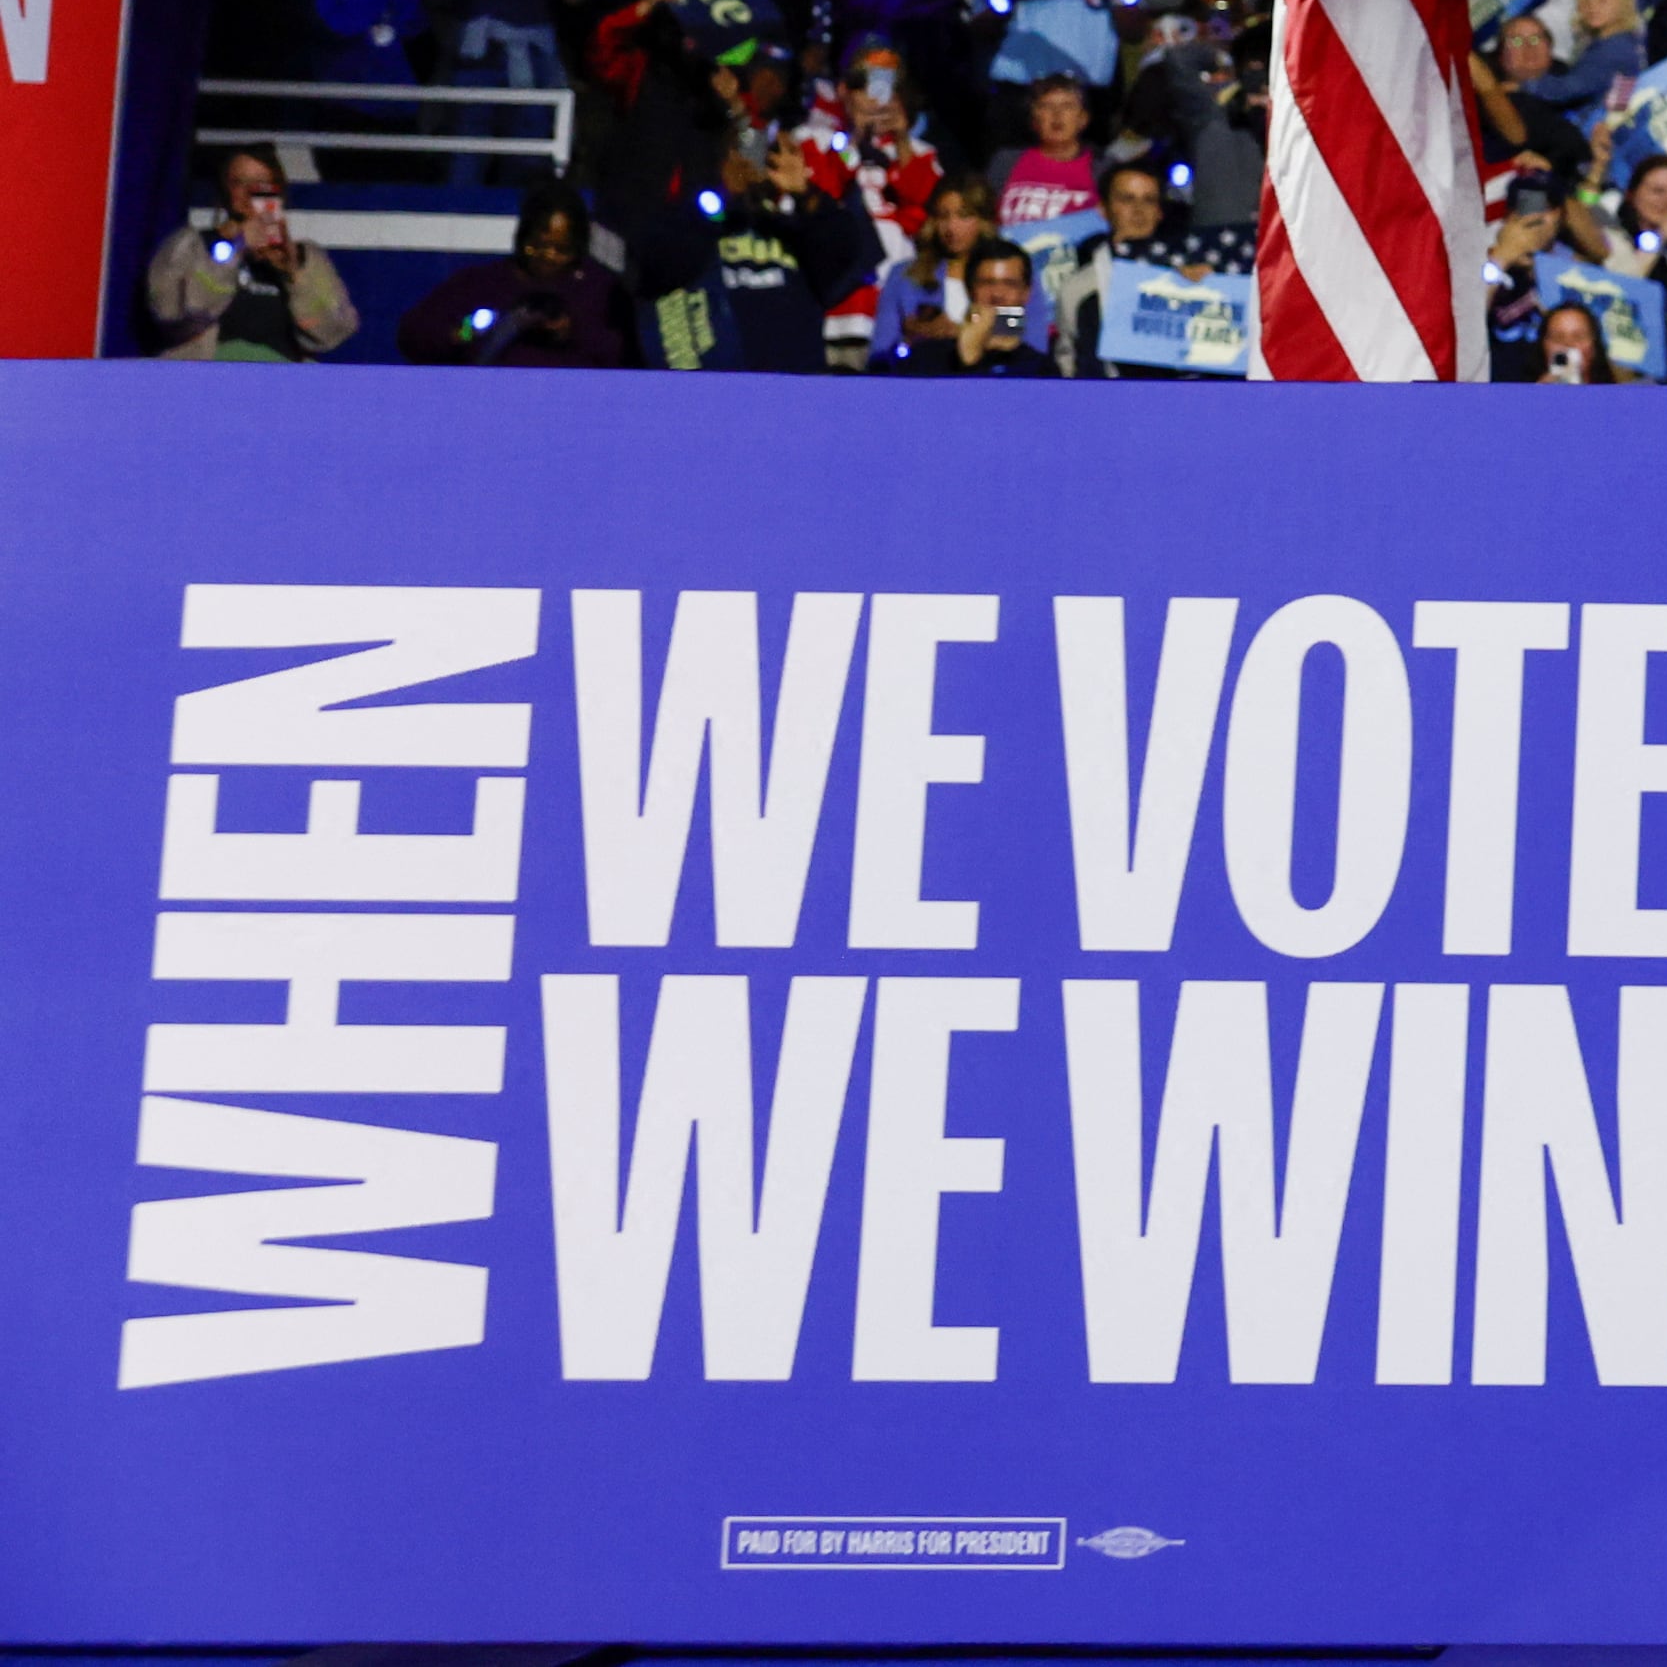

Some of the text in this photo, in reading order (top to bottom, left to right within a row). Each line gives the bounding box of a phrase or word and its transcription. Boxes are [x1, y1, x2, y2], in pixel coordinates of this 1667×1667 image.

[571, 589, 999, 949] WE
[118, 584, 541, 1389] WHEN
[541, 974, 1020, 1381] WE
[737, 1530, 1050, 1556] PAID FOR BY HARRIS FOR PRESIDENT
